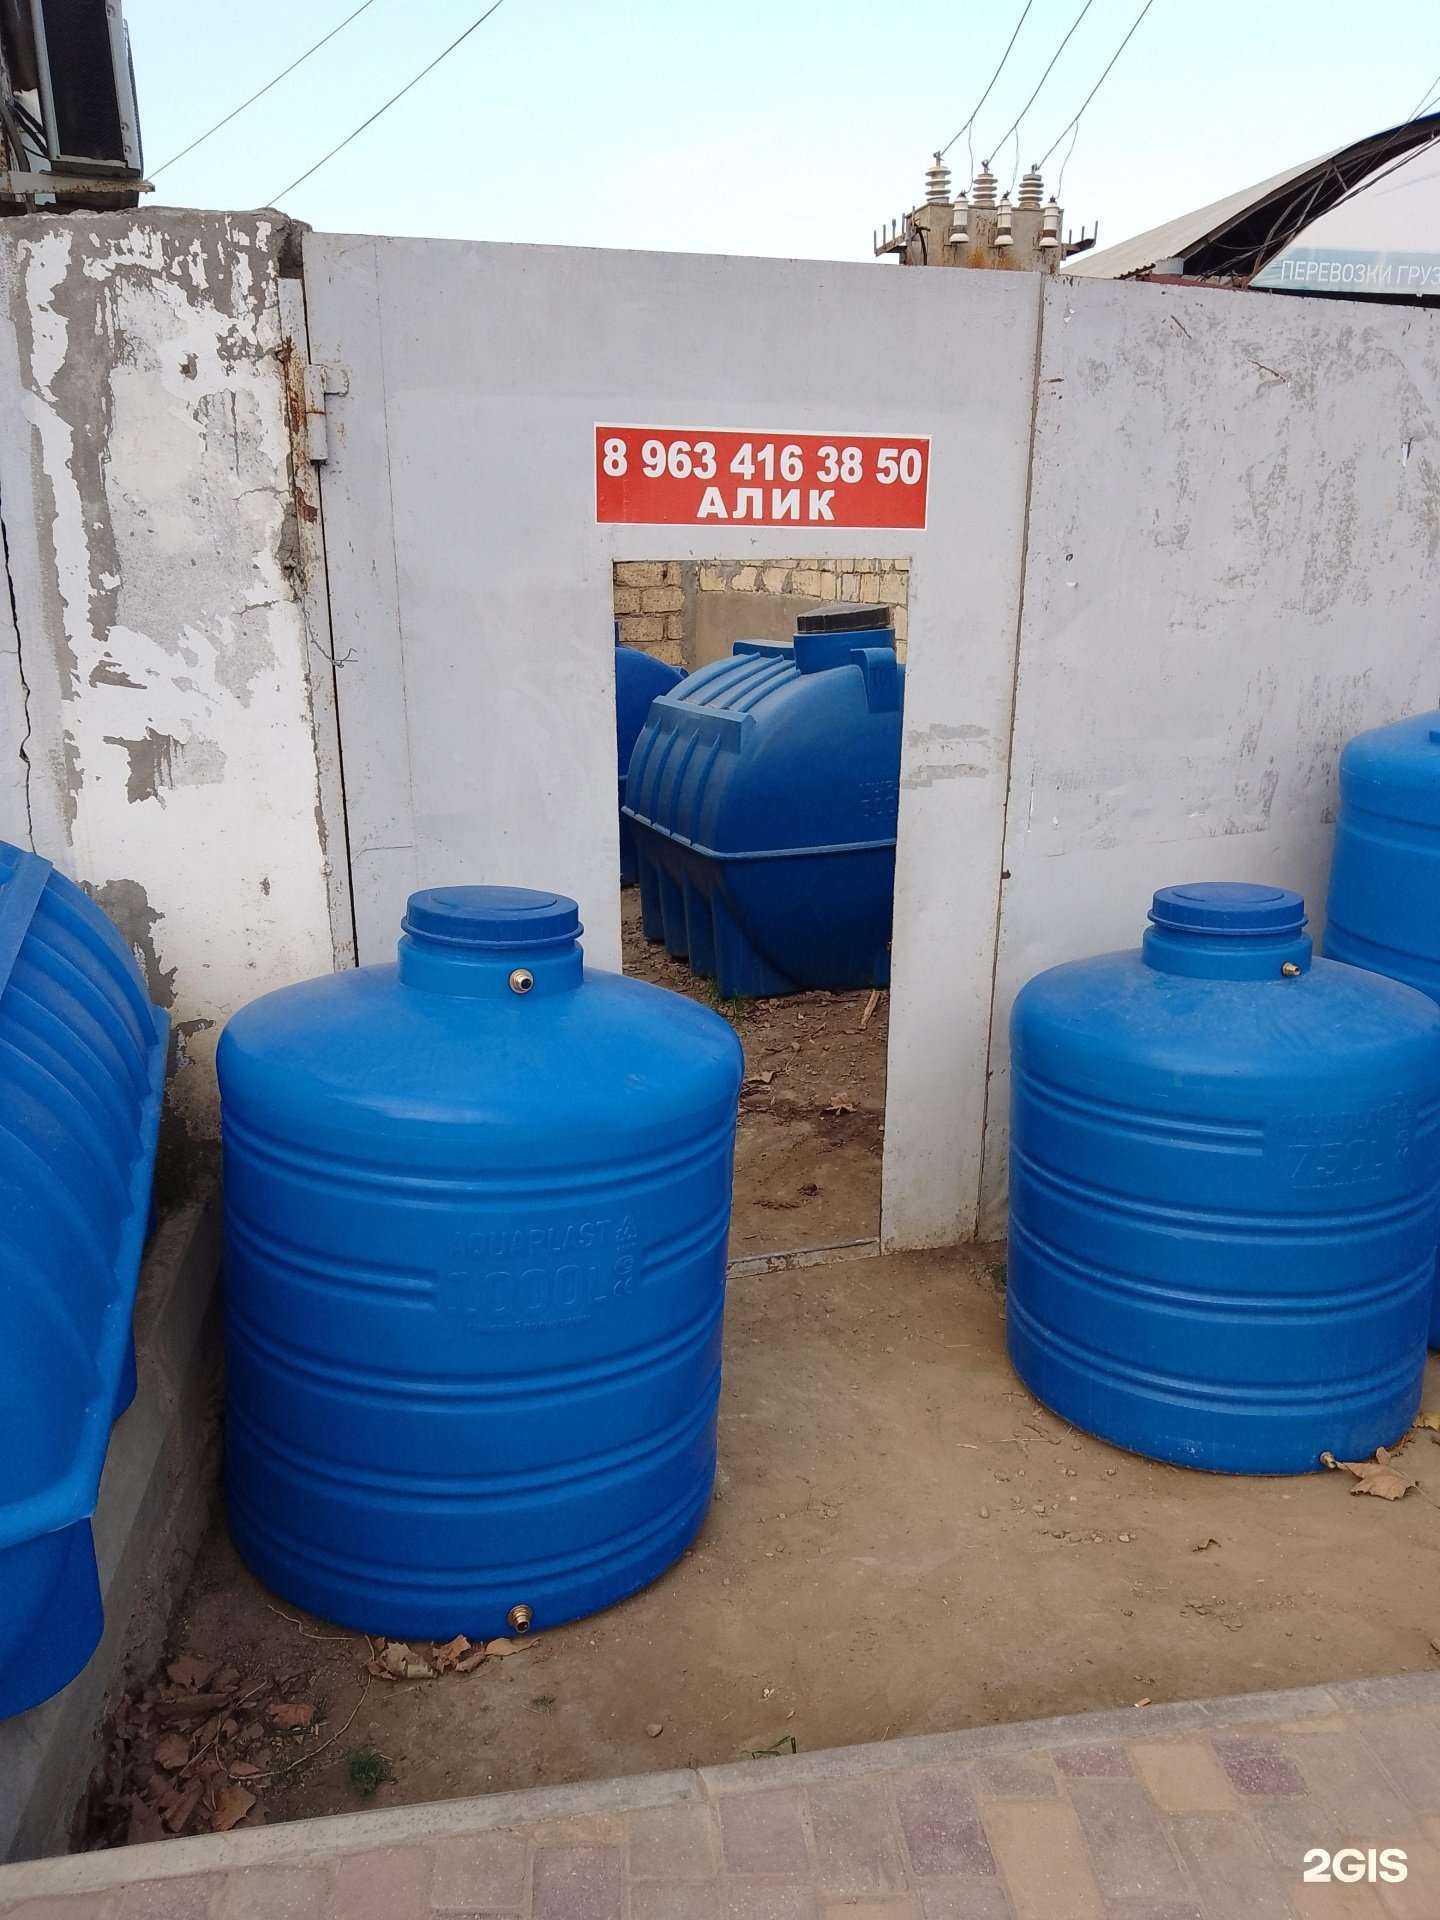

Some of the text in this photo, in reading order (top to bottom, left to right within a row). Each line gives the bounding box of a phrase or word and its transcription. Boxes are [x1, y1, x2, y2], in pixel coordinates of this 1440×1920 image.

[1280, 260, 1392, 284] ПЕРЕВОЗКИ
[603, 438, 923, 485] 8 963 416 38 50
[696, 486, 836, 521] АЛИК
